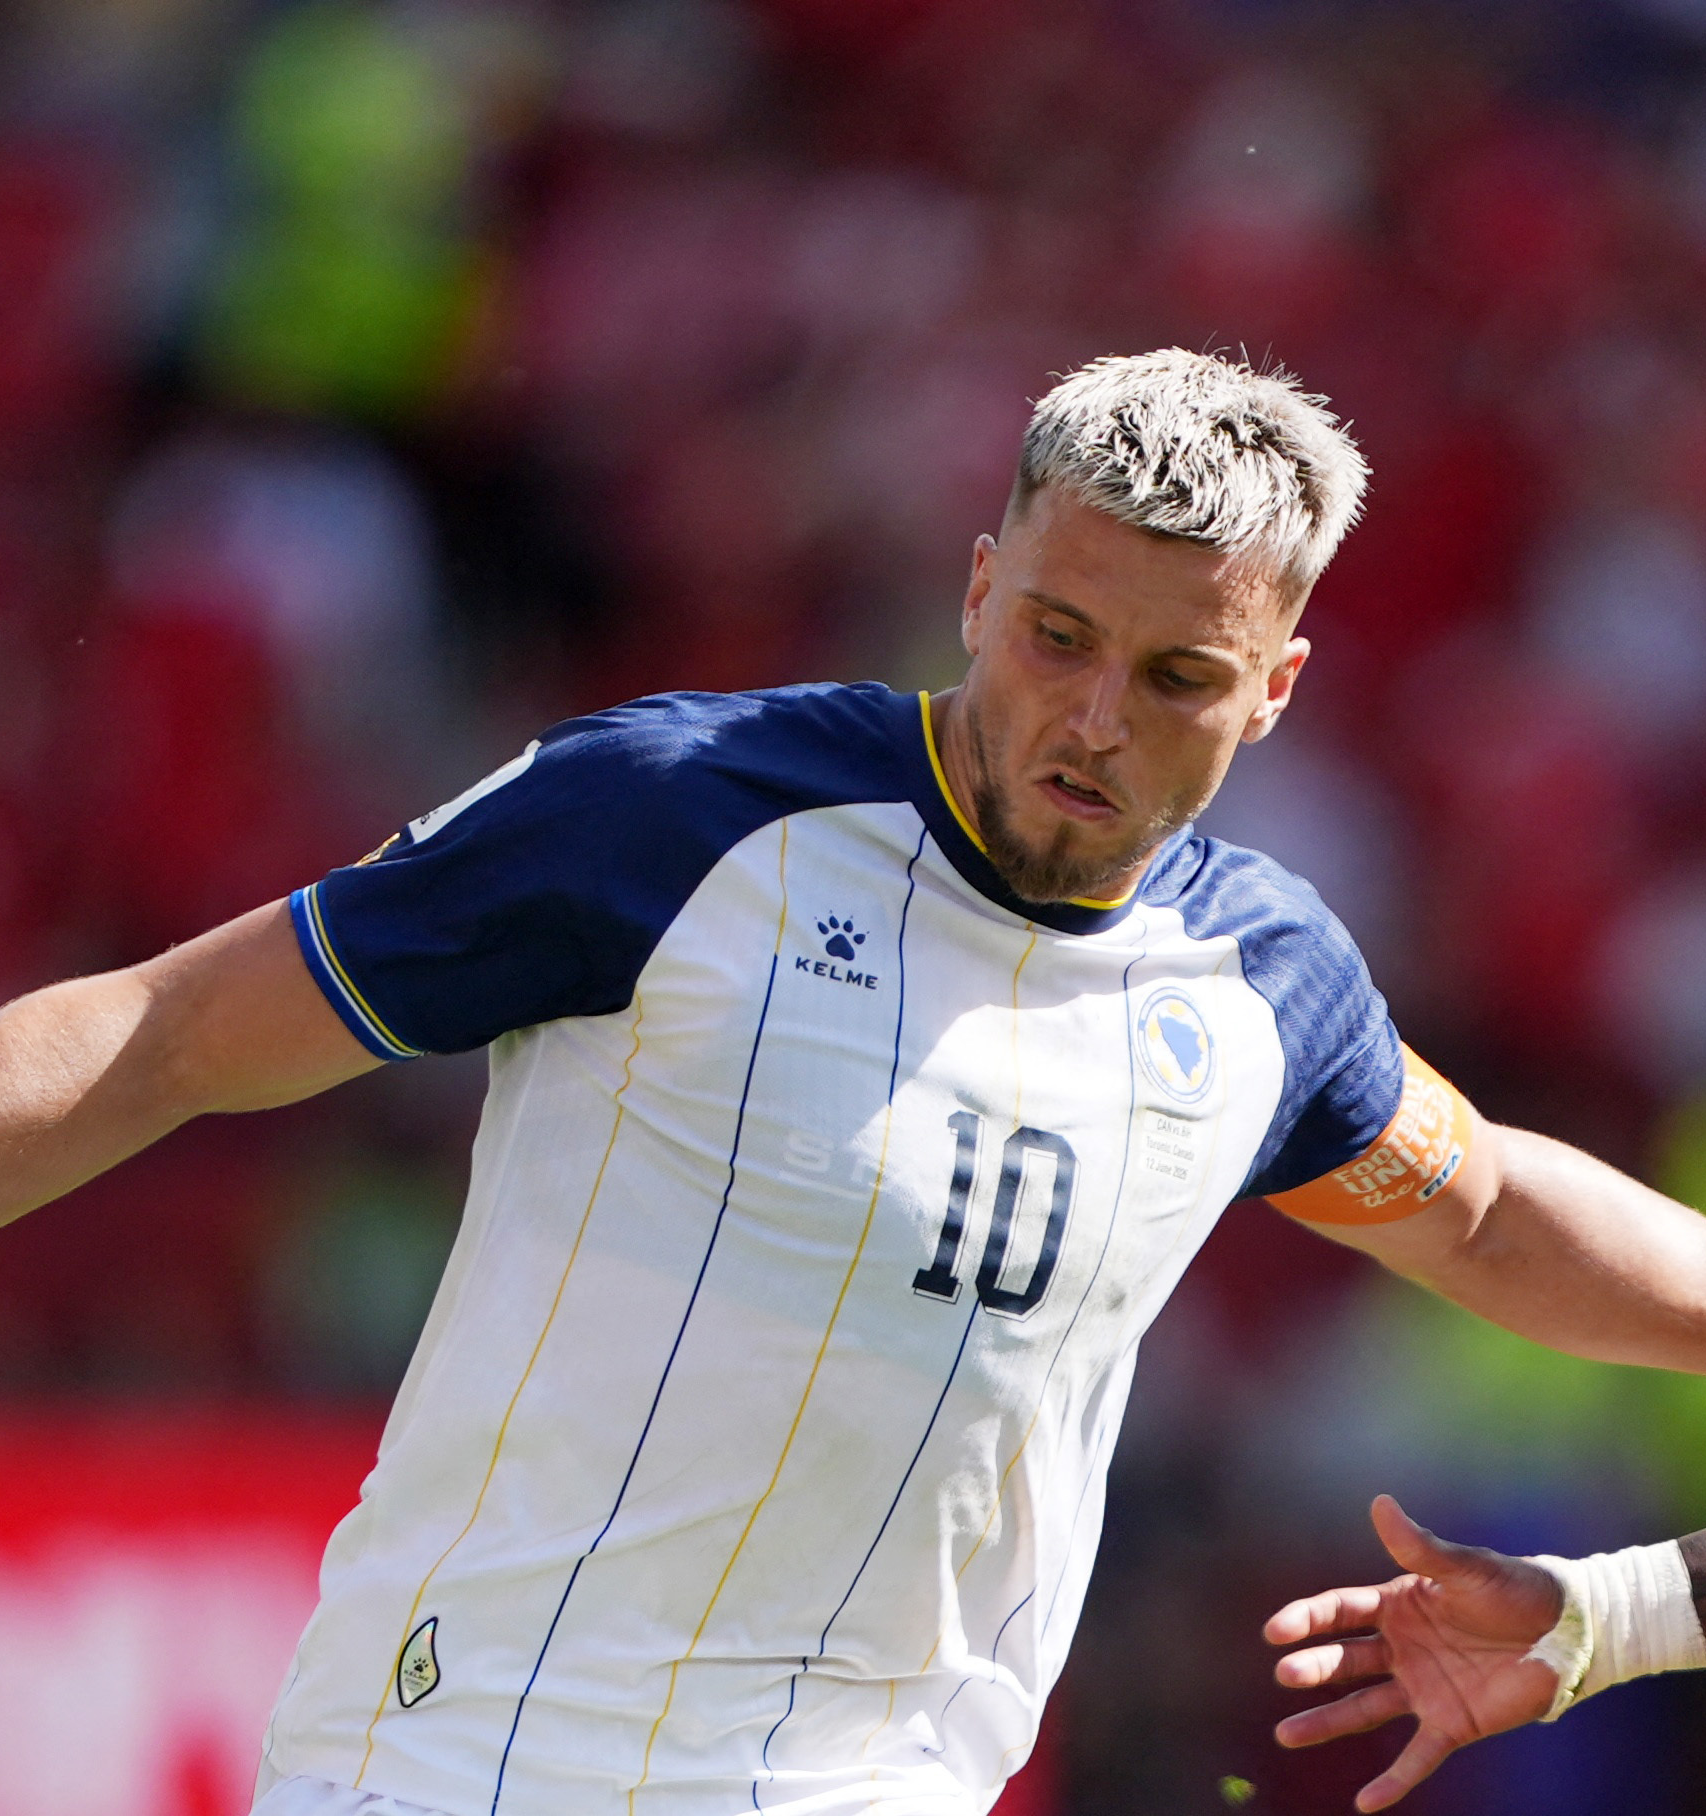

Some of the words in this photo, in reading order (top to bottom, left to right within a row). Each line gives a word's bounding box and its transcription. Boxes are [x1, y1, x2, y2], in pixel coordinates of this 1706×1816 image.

[795, 955, 878, 990] KELME
[1344, 1083, 1440, 1194] UNITES
[1146, 1157, 1156, 1170] 12
[1423, 1153, 1461, 1198] FIFA
[912, 1110, 1081, 1322] 10
